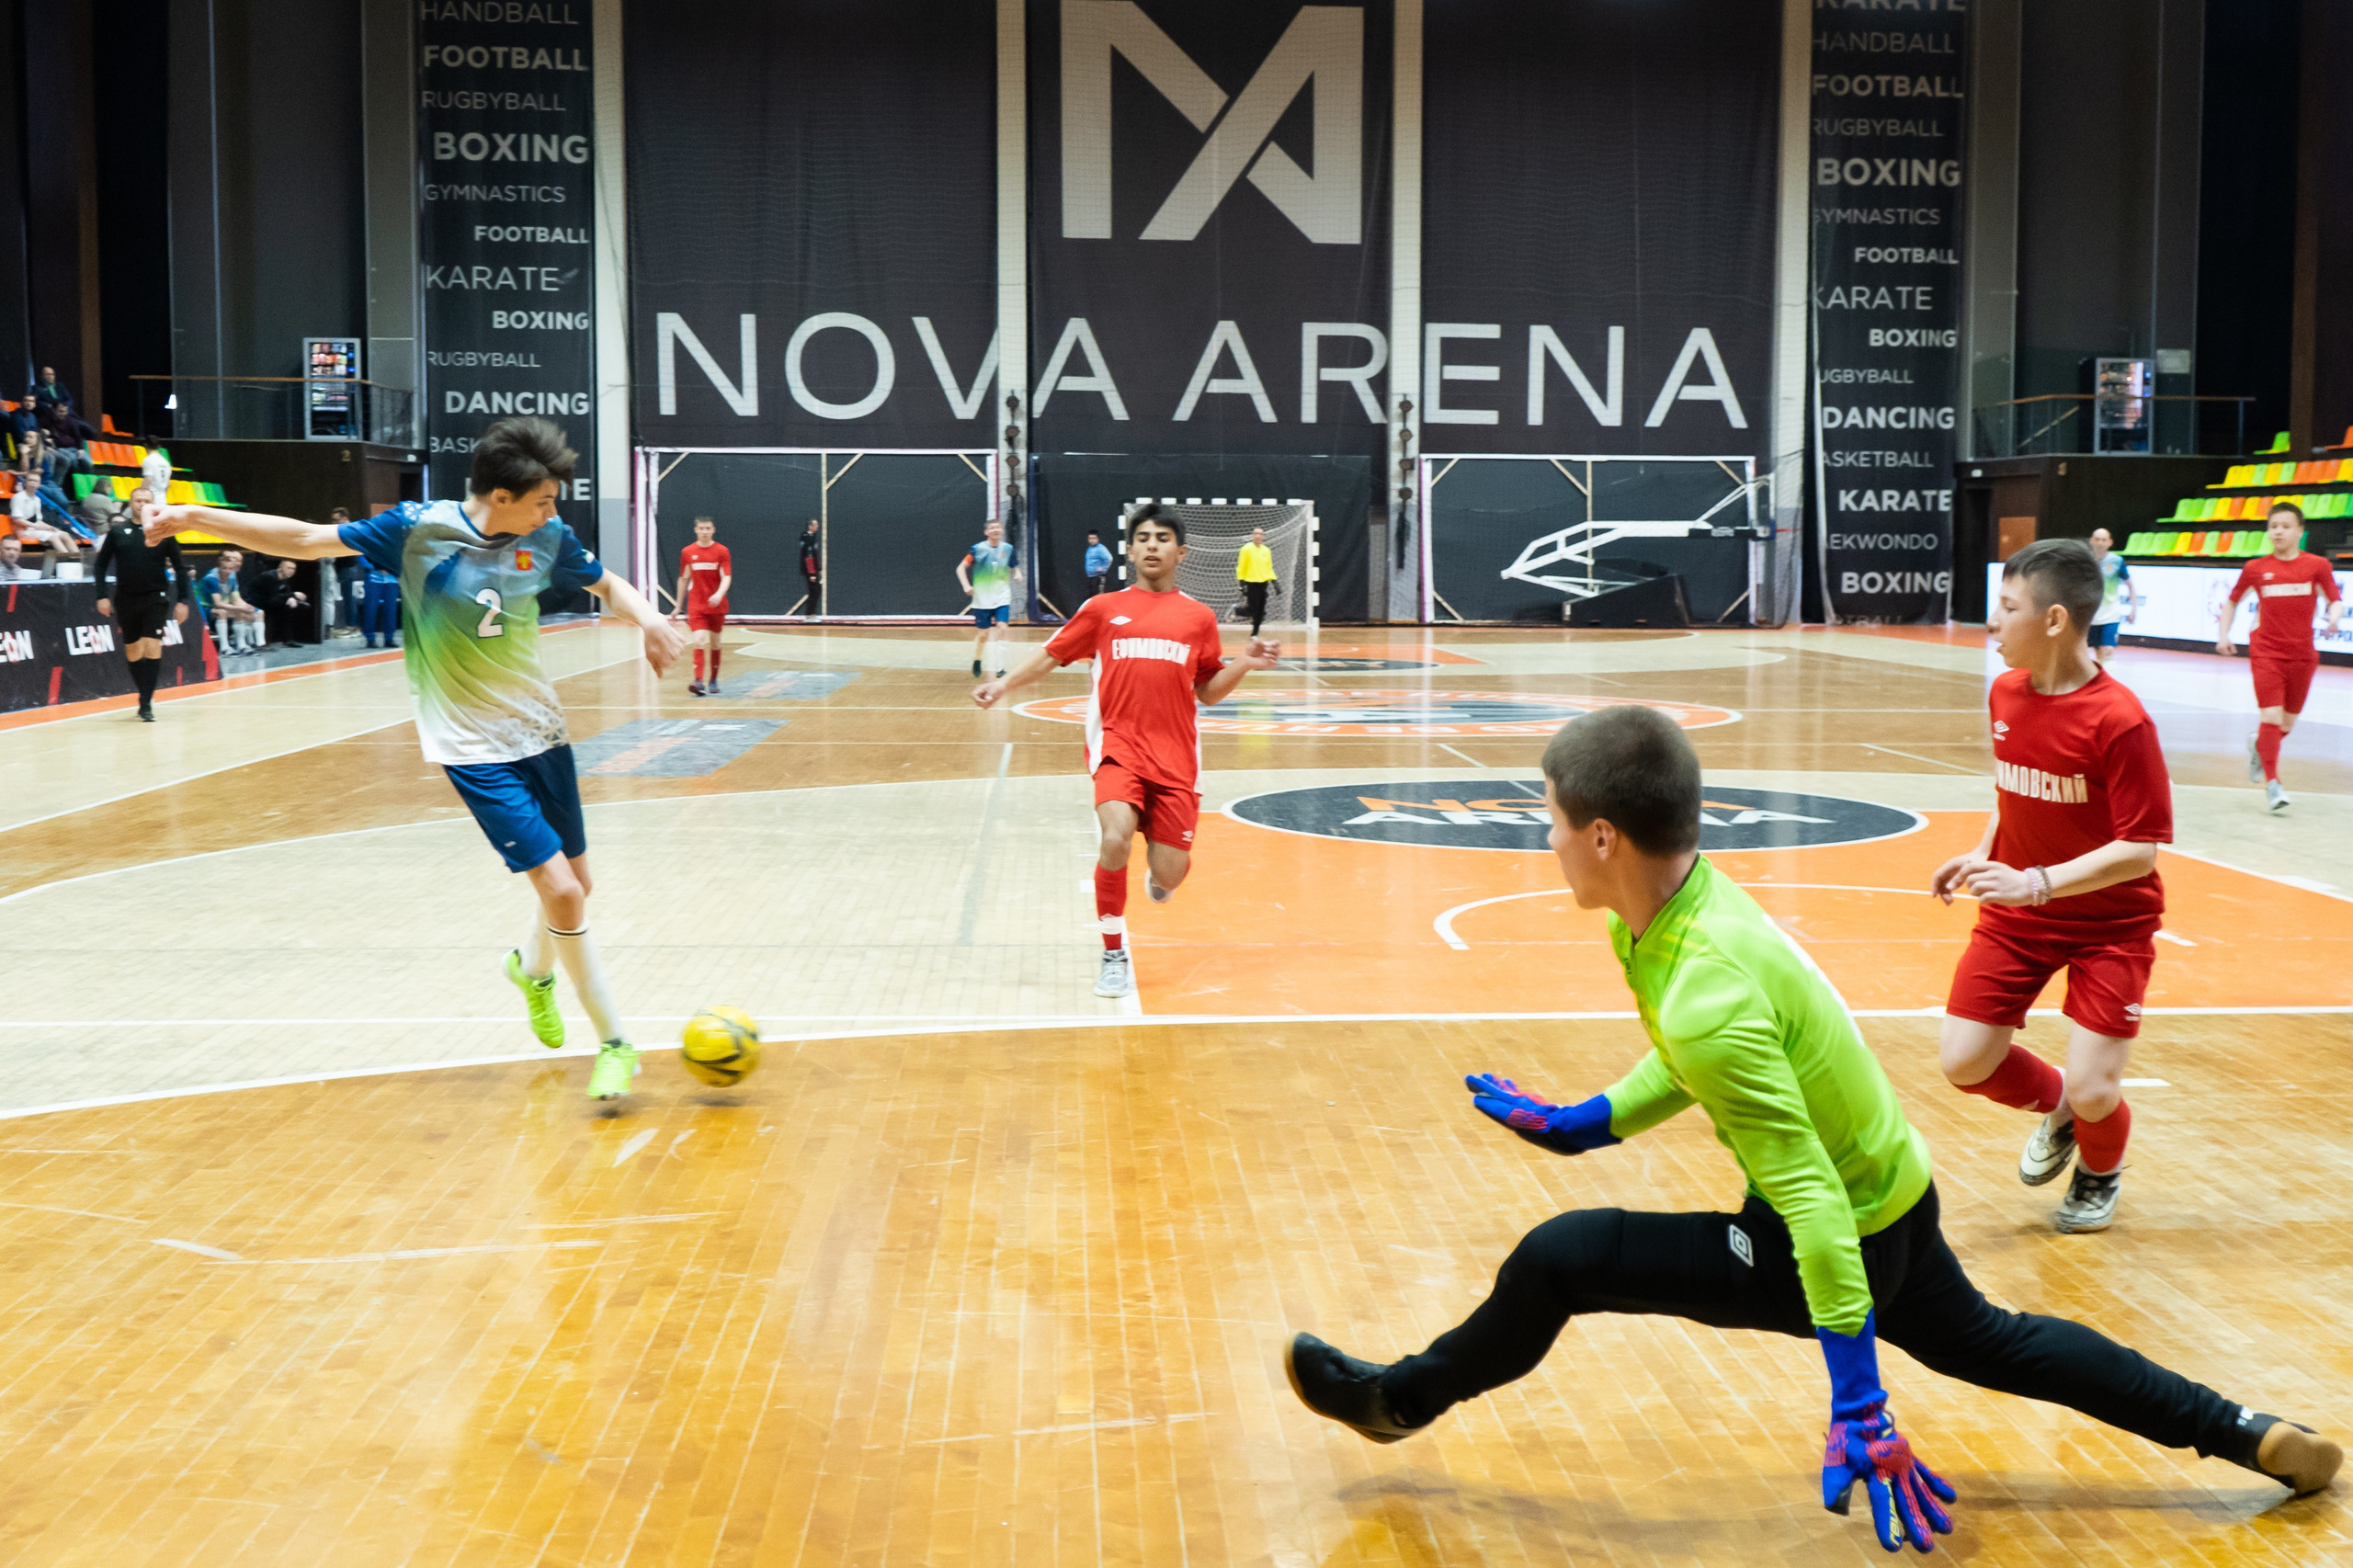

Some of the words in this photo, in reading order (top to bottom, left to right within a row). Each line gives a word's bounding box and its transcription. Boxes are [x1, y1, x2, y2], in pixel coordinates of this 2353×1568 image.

[421, 2, 580, 24] HANDBALL
[424, 45, 589, 71] FOOTBALL
[1813, 74, 1964, 98] FOOTBALL
[421, 91, 566, 111] RUGBYBALL
[433, 131, 589, 164] BOXING
[1816, 157, 1961, 187] BOXING
[424, 184, 566, 202] GYMNASTICS
[473, 225, 589, 244] FOOTBALL
[1854, 246, 1960, 265] FOOTBALL
[425, 265, 560, 291] KARATE
[492, 310, 588, 330] BOXING
[1869, 328, 1958, 348] BOXING
[427, 350, 541, 368] RUGBYBALL
[656, 311, 1130, 422] NOVA
[1171, 319, 1748, 428] ARENA
[1819, 369, 1915, 384] UGBYBALL
[445, 391, 590, 415] DANCING
[1822, 406, 1955, 429] DANCING
[1822, 450, 1935, 468] ASKETBALL
[1838, 489, 1953, 512] KARATE
[1827, 533, 1938, 551] EKWONDO
[1840, 571, 1952, 595] BOXING
[475, 586, 505, 639] 2
[64, 624, 116, 655] LEON
[1996, 759, 2088, 804] ИМОВСКИЙ
